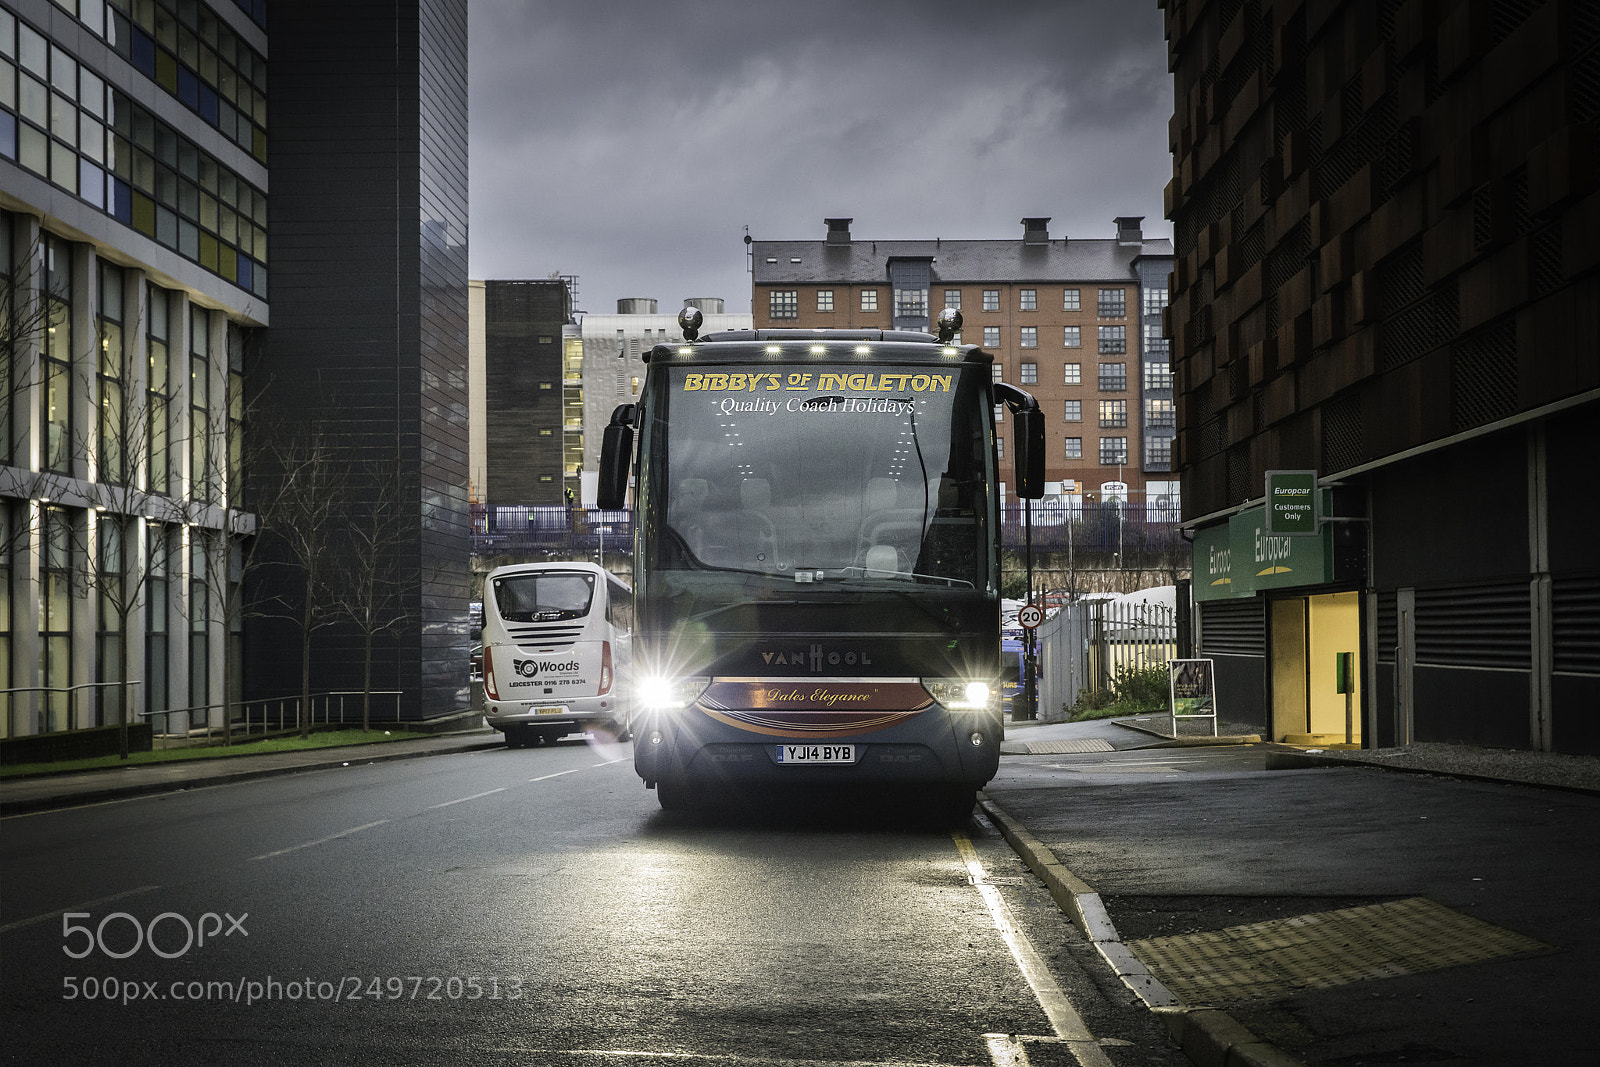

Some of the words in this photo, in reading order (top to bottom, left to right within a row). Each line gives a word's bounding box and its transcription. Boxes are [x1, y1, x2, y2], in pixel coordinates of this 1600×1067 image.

[684, 373, 781, 392] BIBBY'S
[786, 373, 812, 390] OF
[817, 373, 952, 392] INGLETON
[720, 397, 781, 415] Quality
[786, 397, 837, 413] Coach
[841, 397, 915, 415] Holidays
[1274, 487, 1310, 496] Europcar
[1284, 513, 1301, 521] Only
[1209, 545, 1231, 580] Europc
[1023, 612, 1039, 622] 20
[540, 660, 579, 672] Woods
[788, 747, 819, 759] YJ14
[823, 747, 850, 759] BYB
